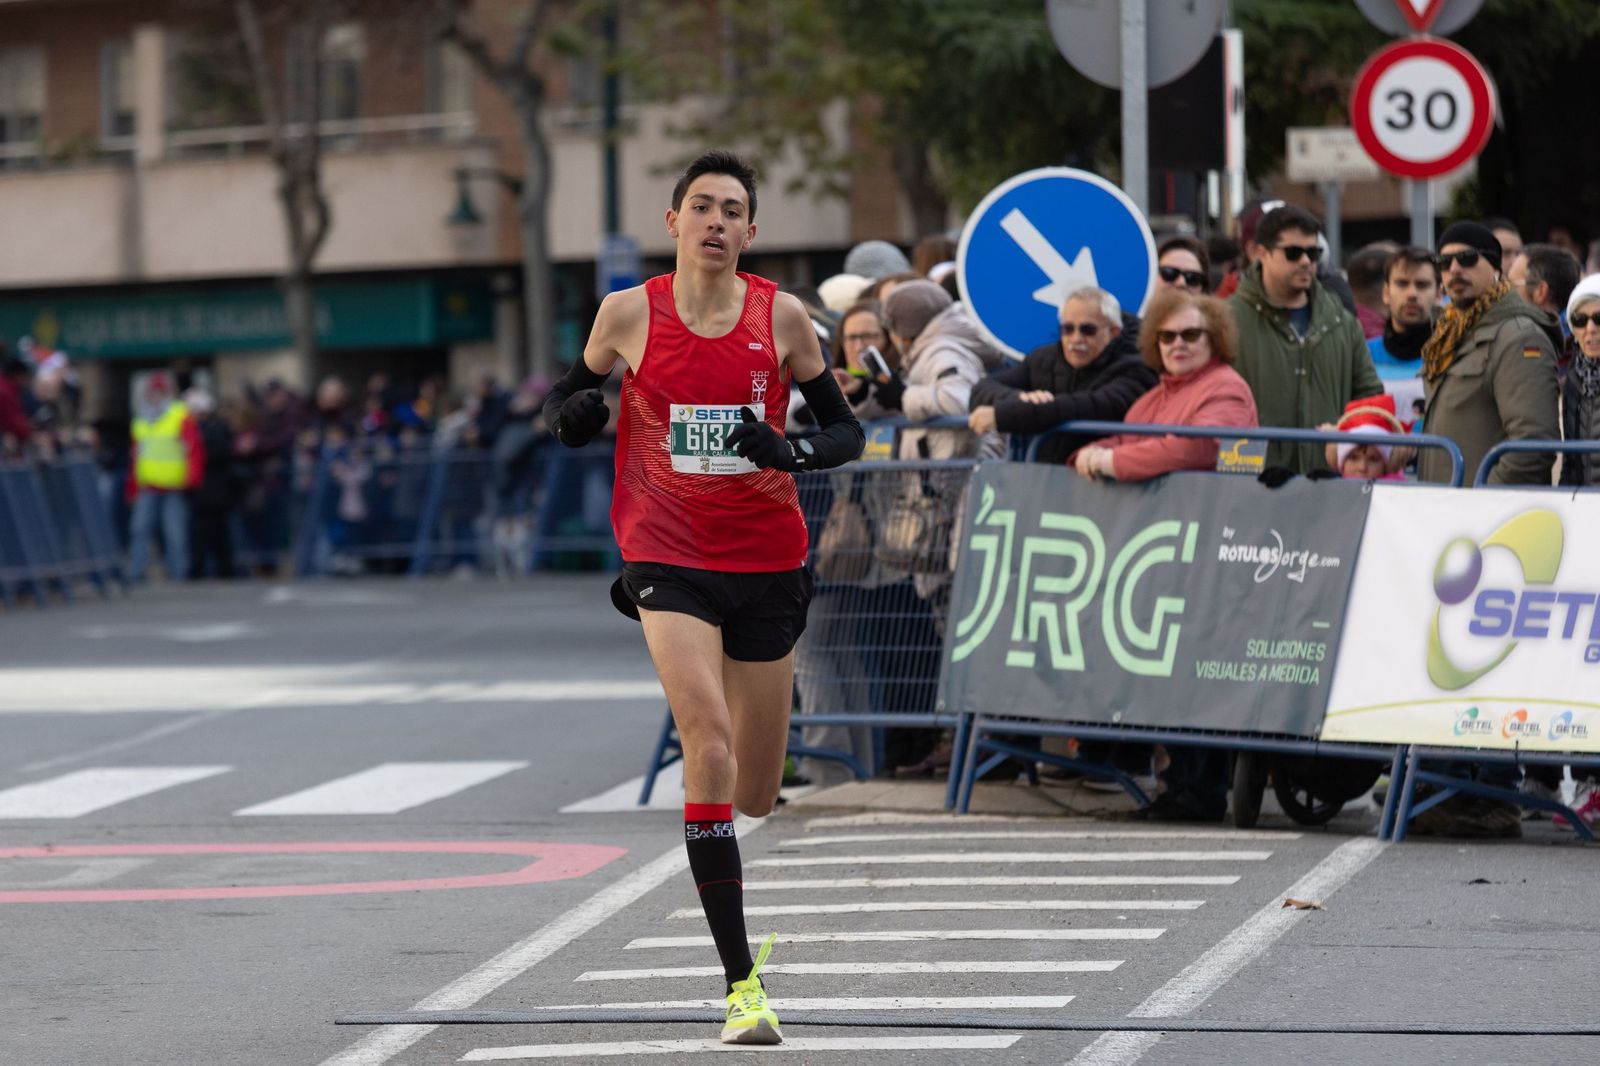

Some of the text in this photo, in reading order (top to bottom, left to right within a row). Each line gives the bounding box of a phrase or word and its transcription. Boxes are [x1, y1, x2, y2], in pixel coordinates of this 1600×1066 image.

[1385, 88, 1457, 131] 30
[695, 409, 742, 420] SETE
[1223, 526, 1236, 540] by
[1246, 639, 1327, 662] SOLUCIONES
[1196, 660, 1320, 685] VISUALES A MEDIDA
